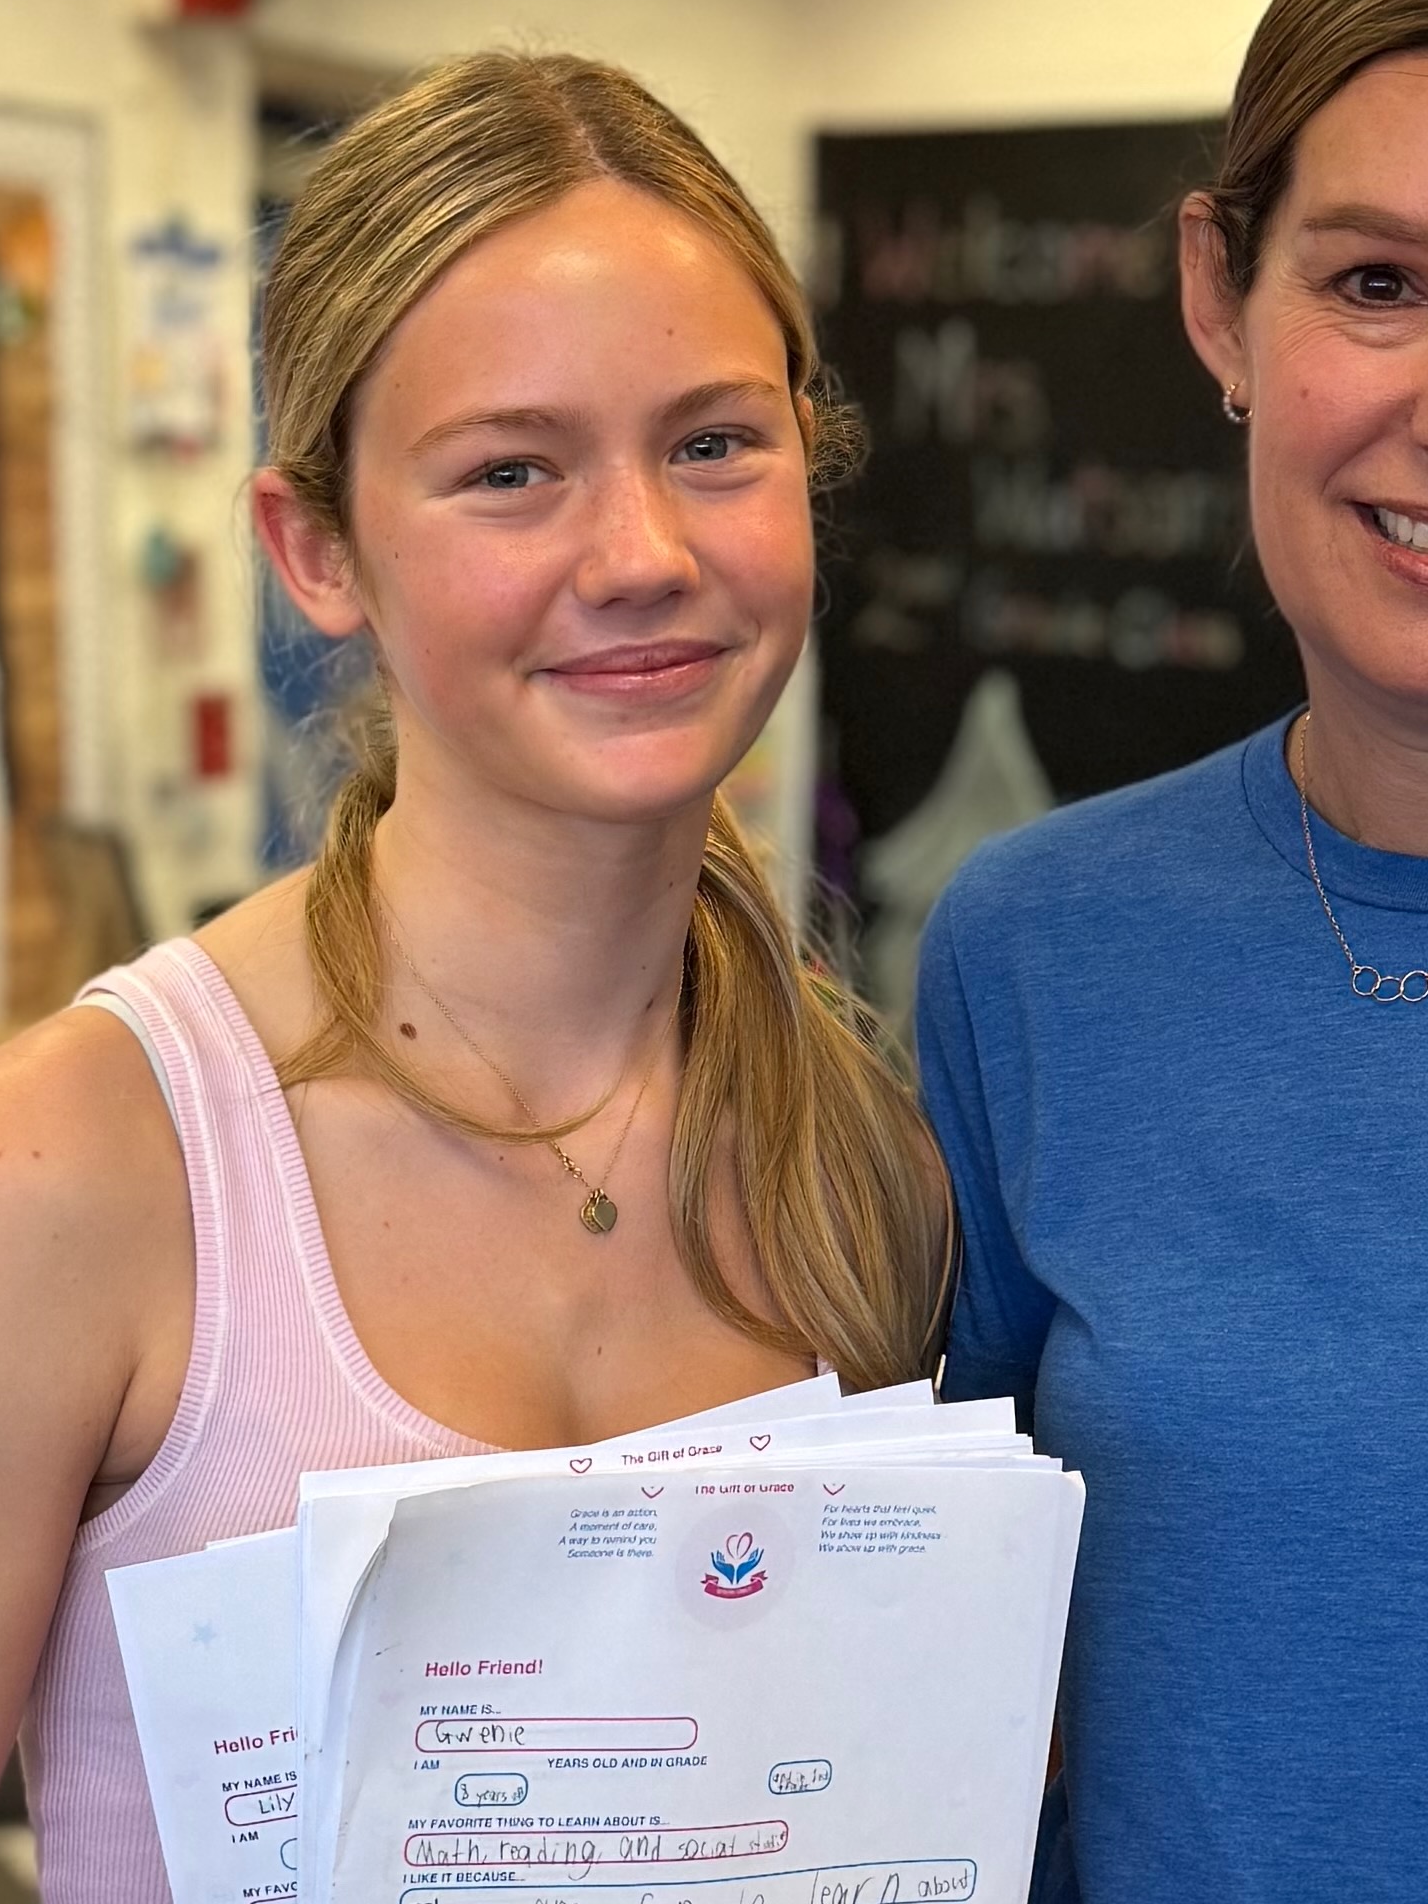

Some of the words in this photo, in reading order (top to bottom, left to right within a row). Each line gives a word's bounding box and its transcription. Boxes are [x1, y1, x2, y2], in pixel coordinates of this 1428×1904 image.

[622, 1455, 644, 1466] The
[647, 1451, 669, 1462] Gift
[672, 1448, 684, 1459] of
[569, 1522, 577, 1532] A
[621, 1521, 632, 1531] of
[558, 1536, 566, 1546] A
[591, 1536, 600, 1545] to
[639, 1536, 657, 1547] you
[425, 1661, 471, 1677] Hello
[478, 1659, 543, 1675] Friend!
[420, 1706, 439, 1716] MY
[441, 1704, 477, 1716] NAME
[214, 1736, 263, 1755] Hello
[269, 1726, 298, 1746] Fri
[414, 1760, 418, 1770] I
[420, 1759, 440, 1770] AM
[547, 1757, 590, 1769] YEARS
[593, 1757, 619, 1768] OLD
[621, 1756, 649, 1768] AND
[651, 1756, 663, 1767] IN
[666, 1755, 708, 1767] GRADE
[222, 1782, 239, 1792] MY
[244, 1774, 282, 1790] NAME
[258, 1792, 295, 1815] Lily
[476, 1790, 508, 1808] years
[408, 1819, 427, 1829] MY
[430, 1818, 493, 1829] FAVORITE
[497, 1817, 534, 1828] THING
[538, 1817, 555, 1827] TO
[558, 1817, 601, 1827] LEARN
[603, 1816, 645, 1827] ABOUT
[232, 1833, 236, 1844] I
[239, 1830, 259, 1843] AM
[619, 1834, 661, 1862] and
[409, 1873, 438, 1884] LIKE
[441, 1873, 453, 1883] IT
[917, 1868, 969, 1898] about
[243, 1886, 261, 1898] MY
